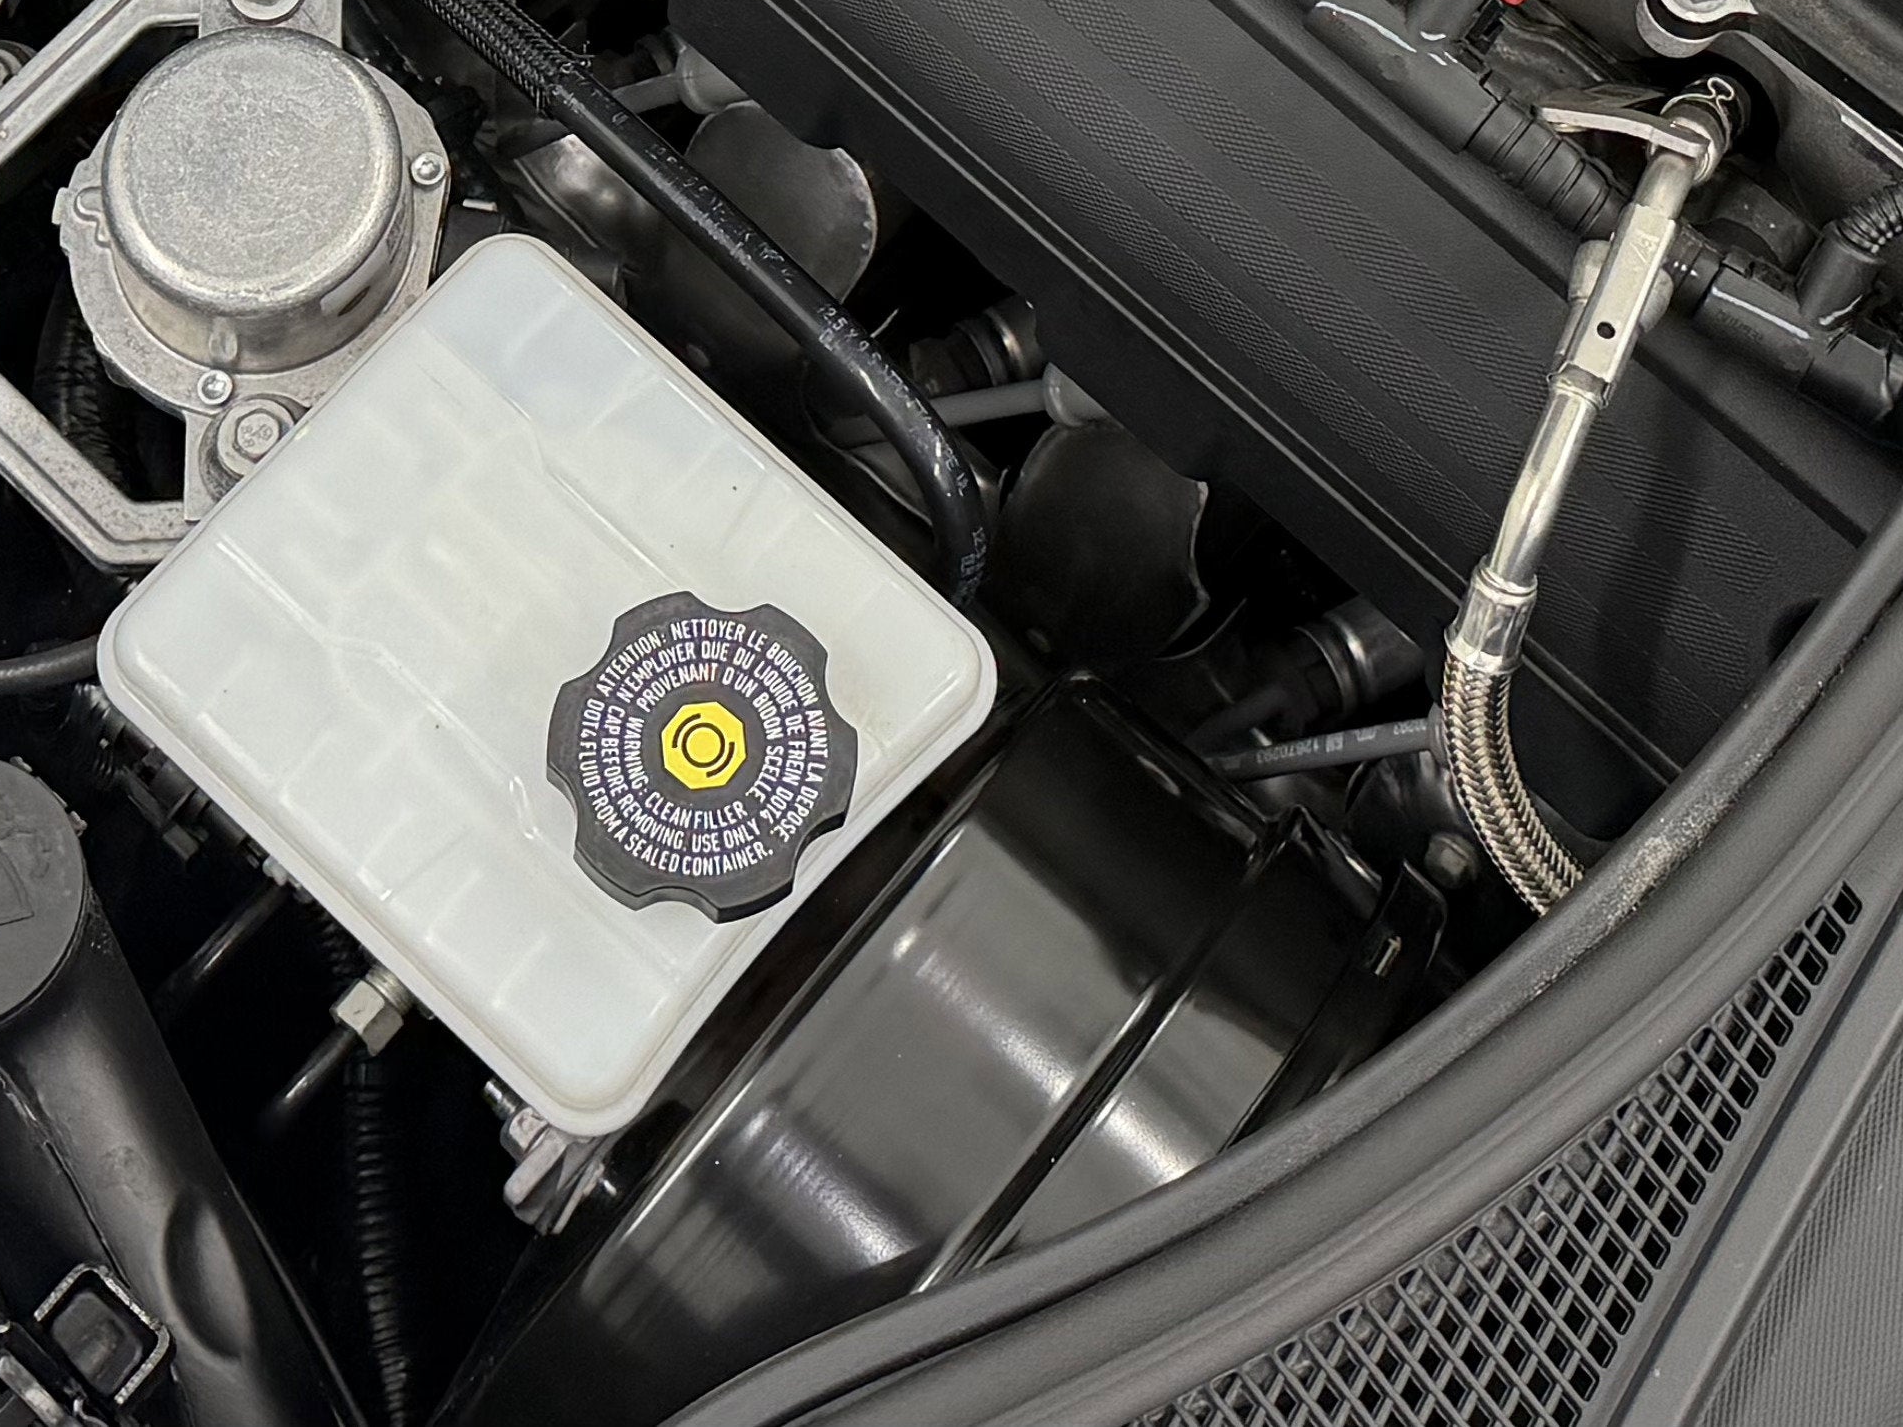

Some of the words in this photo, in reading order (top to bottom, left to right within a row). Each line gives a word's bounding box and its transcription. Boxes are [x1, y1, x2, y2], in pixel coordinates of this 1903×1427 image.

[671, 619, 747, 641] NETTOYER
[748, 629, 770, 651] LE
[596, 631, 667, 697] ATTENTION:
[701, 641, 728, 661] QUE
[733, 647, 756, 669] DU
[616, 642, 696, 704] N'EMPLOYER
[636, 663, 718, 713] PROVENANT
[722, 668, 756, 697] D'UN
[753, 660, 798, 713] LIQUIDE
[766, 643, 818, 707] BOUCHON
[579, 699, 604, 740] DOT4
[602, 704, 626, 738] CAP
[752, 695, 784, 741] BIDON
[785, 713, 805, 737] DE
[806, 705, 829, 759] AVANT
[578, 740, 599, 788] FLUID
[601, 739, 626, 796] BEFORE
[744, 745, 784, 805] SCELLE.
[783, 740, 806, 783] FREIN
[805, 763, 827, 783] LA
[587, 787, 622, 834] FROM
[615, 790, 688, 852] REMOVING.
[644, 790, 691, 827] CLEAN
[692, 800, 748, 829] FILLER
[759, 786, 794, 825] DOT4
[612, 827, 626, 844] A
[691, 836, 721, 853] USE
[723, 817, 762, 850] ONLY
[624, 835, 679, 874] SEALED
[681, 840, 774, 876] CONTAINER.
